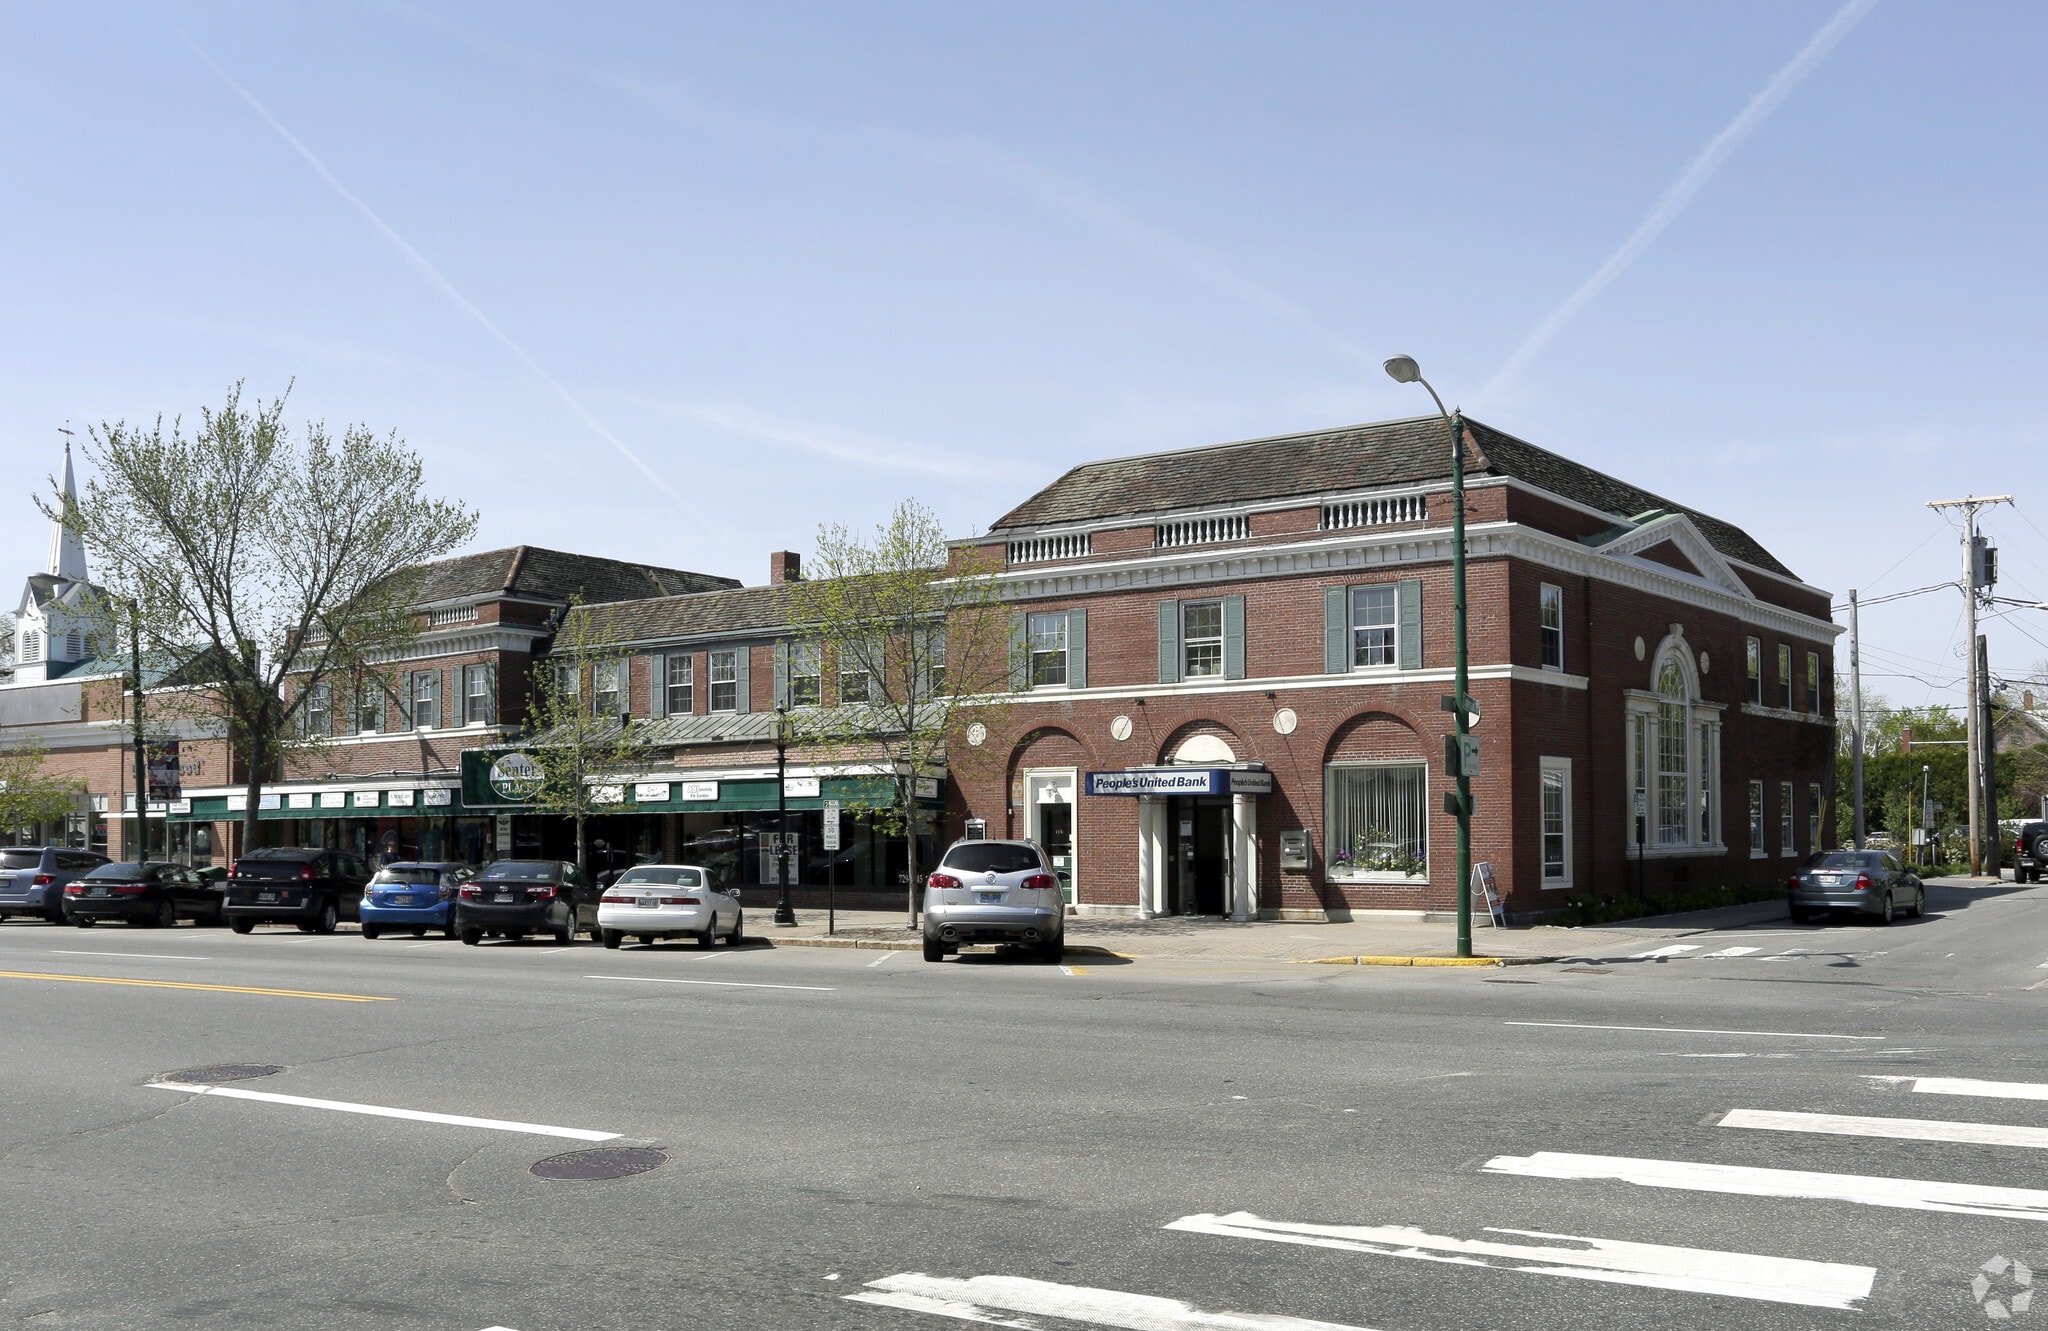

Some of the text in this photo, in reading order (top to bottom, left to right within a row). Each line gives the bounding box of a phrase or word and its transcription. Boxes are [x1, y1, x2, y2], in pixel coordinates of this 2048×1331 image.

[497, 761, 537, 778] Senter
[1095, 776, 1207, 791] People's United Bank
[1247, 778, 1260, 786] United
[1260, 778, 1271, 787] Bank
[773, 834, 794, 844] FR
[769, 845, 798, 856] LESE
